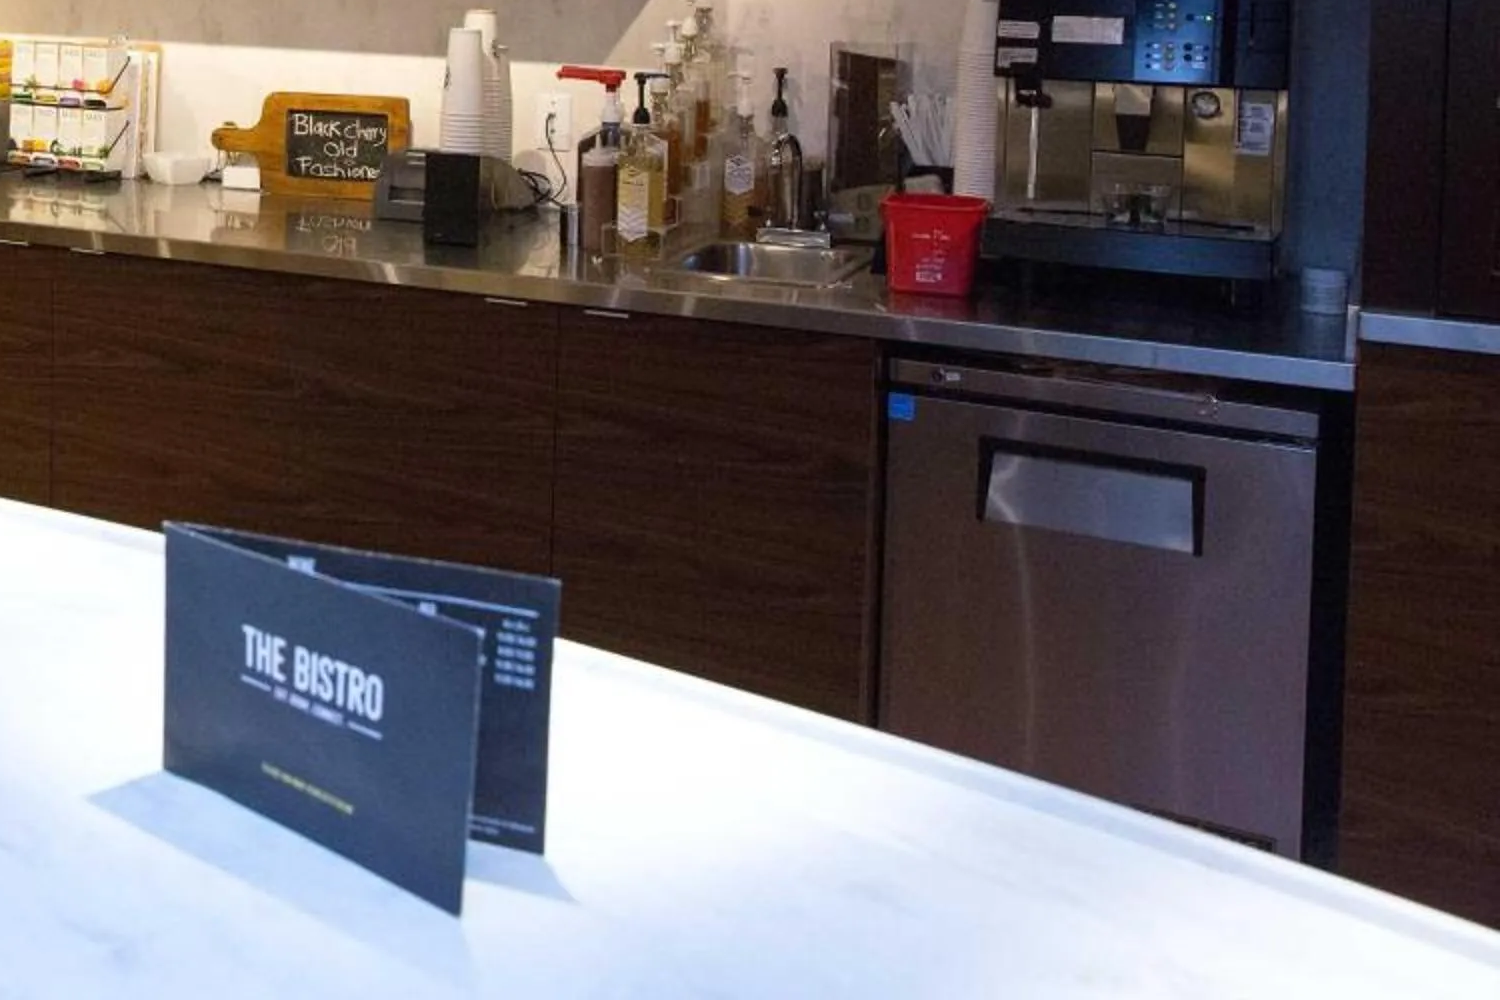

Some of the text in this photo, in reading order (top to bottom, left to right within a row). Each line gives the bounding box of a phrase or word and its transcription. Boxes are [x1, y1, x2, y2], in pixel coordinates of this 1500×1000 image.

[292, 113, 342, 139] Black
[323, 139, 358, 159] Old
[294, 156, 381, 180] Fashione
[241, 624, 287, 682] THE
[294, 645, 384, 722] BISTRO
